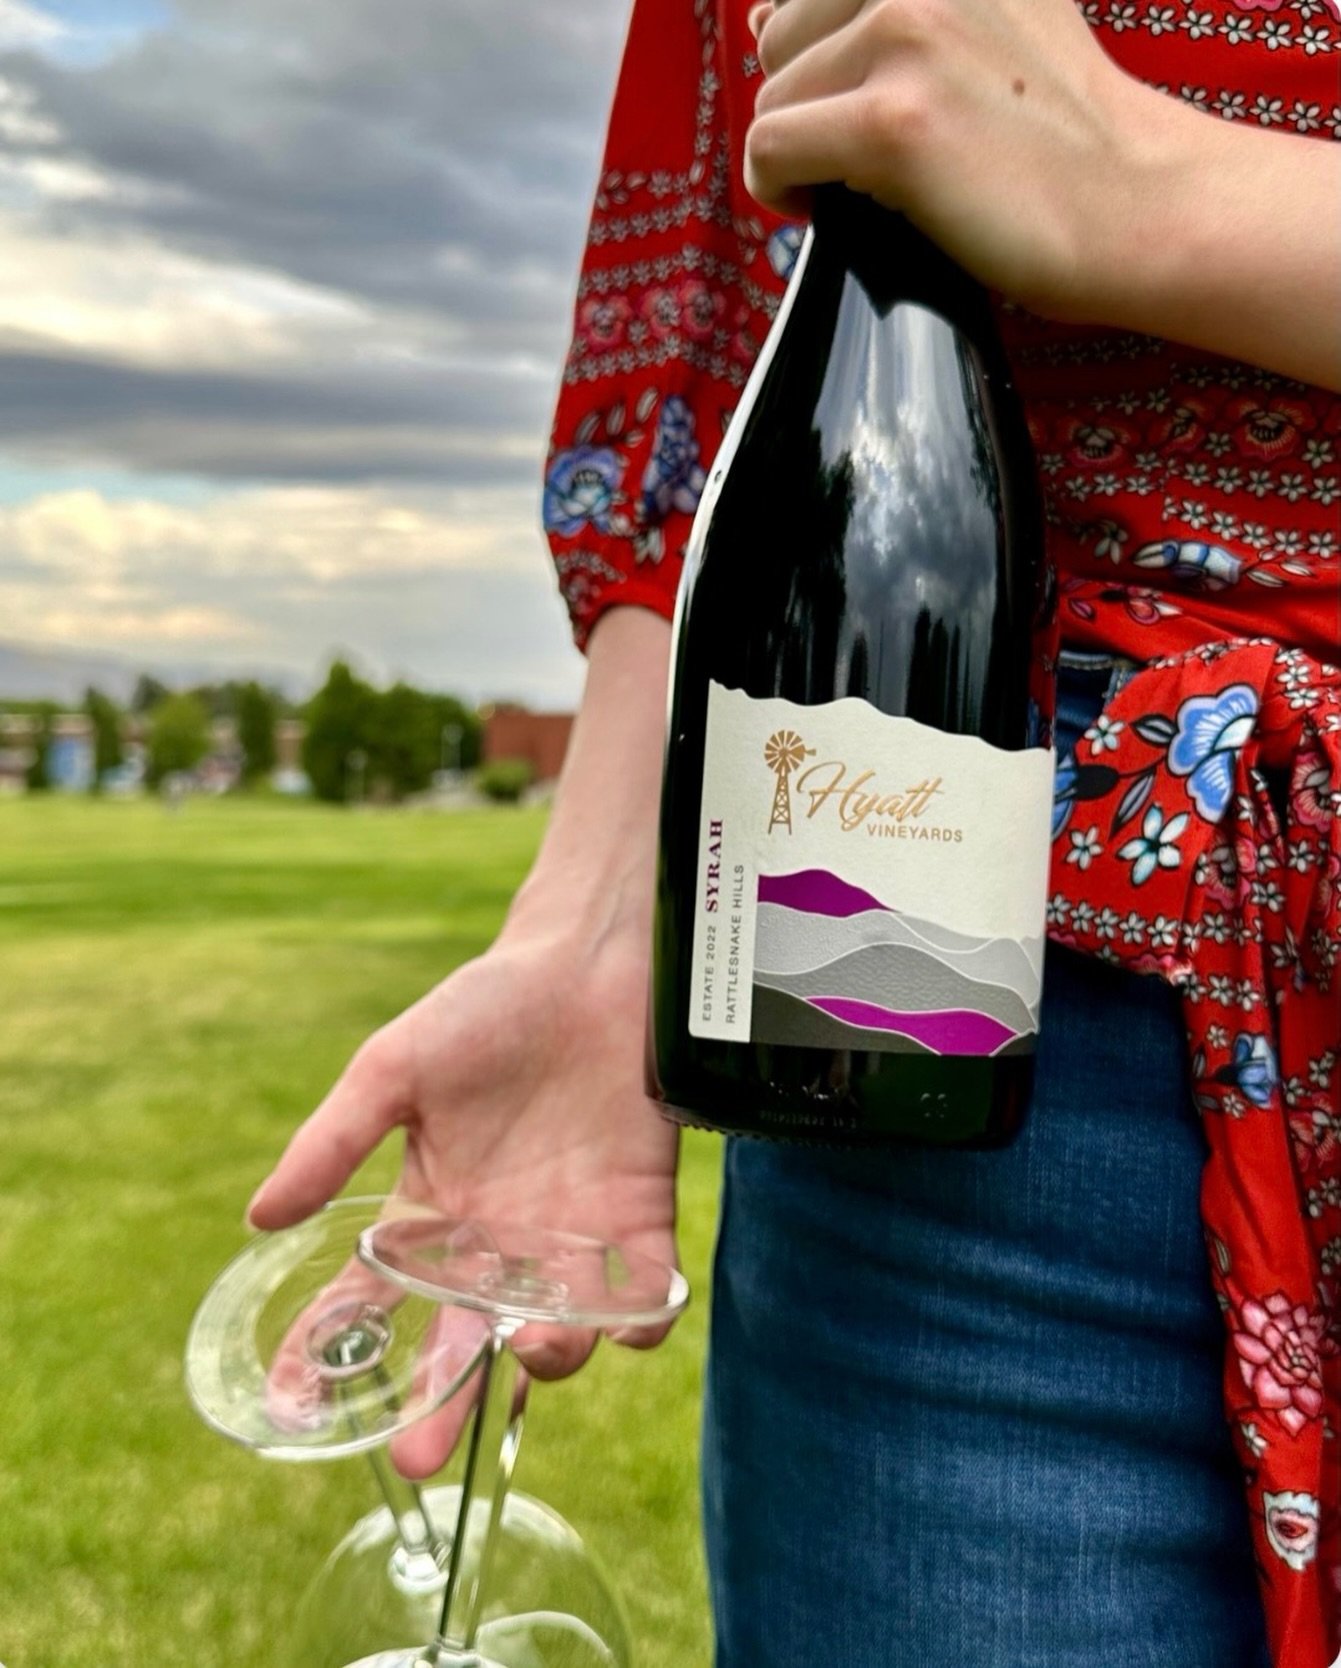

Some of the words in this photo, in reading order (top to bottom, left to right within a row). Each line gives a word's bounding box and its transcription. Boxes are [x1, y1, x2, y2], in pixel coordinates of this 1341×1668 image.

[796, 761, 944, 831] Hyatt
[867, 824, 962, 842] VINEYARDS
[705, 820, 723, 913] SYRAH
[705, 925, 716, 961] 2022
[726, 914, 742, 1024] RATTLESNAKE
[734, 865, 744, 909] HILLS
[702, 967, 714, 1021] ESTATE
